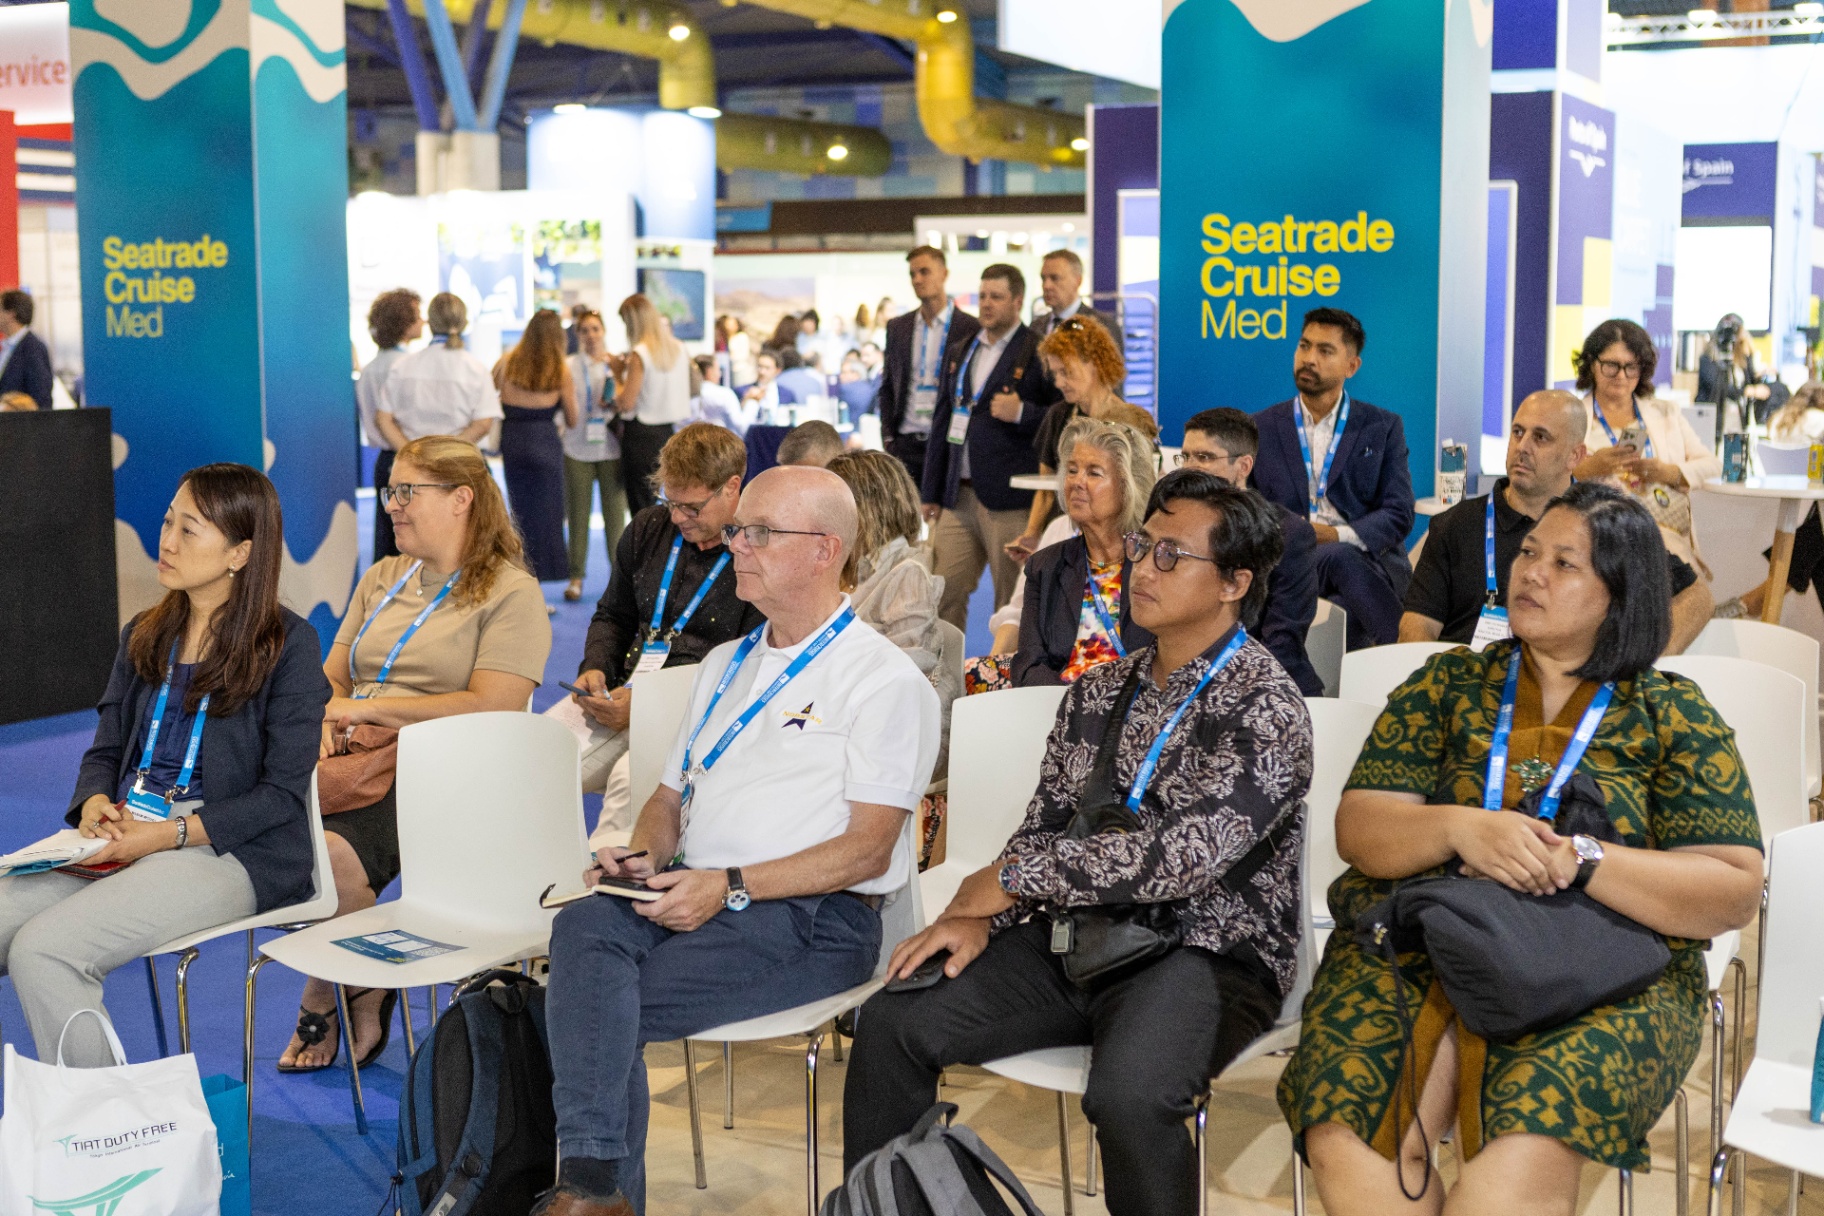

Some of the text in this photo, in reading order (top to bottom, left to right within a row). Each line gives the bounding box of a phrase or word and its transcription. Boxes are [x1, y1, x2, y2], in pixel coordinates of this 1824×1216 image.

[0, 53, 67, 87] rvice
[1201, 210, 1396, 254] Seatrade
[103, 233, 229, 269] Seatrade
[104, 269, 196, 304] Cruise
[1200, 255, 1342, 298] Cruise
[105, 304, 164, 338] Med
[1201, 298, 1288, 340] Med
[72, 1122, 177, 1152] TIAT DUTY FREE
